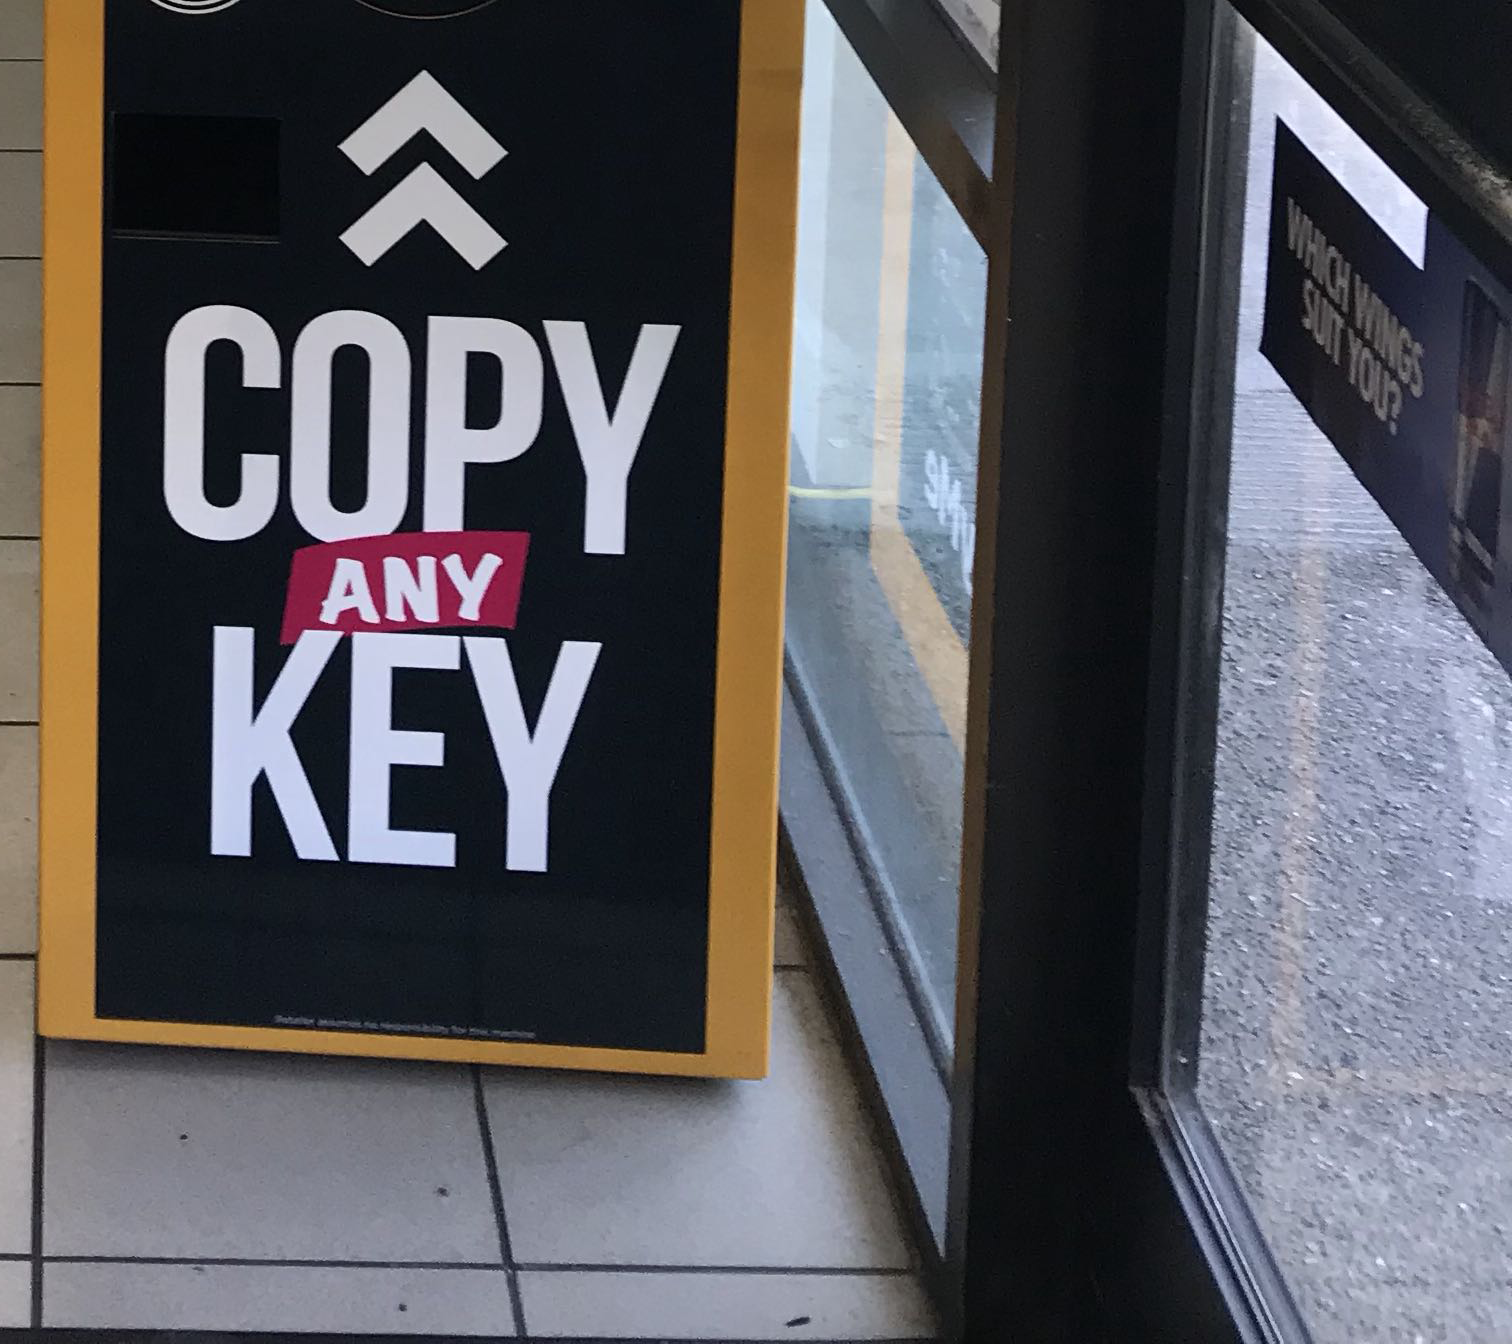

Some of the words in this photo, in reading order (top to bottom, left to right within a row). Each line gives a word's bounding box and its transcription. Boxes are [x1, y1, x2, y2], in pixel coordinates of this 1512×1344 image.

[1287, 196, 1352, 315] WHICH
[1354, 272, 1425, 399] WINGS
[1301, 277, 1345, 366] SUIT
[1347, 325, 1404, 437] YOU?
[162, 304, 683, 556] COPY
[319, 552, 504, 625] ANY
[210, 625, 603, 872] KEY
